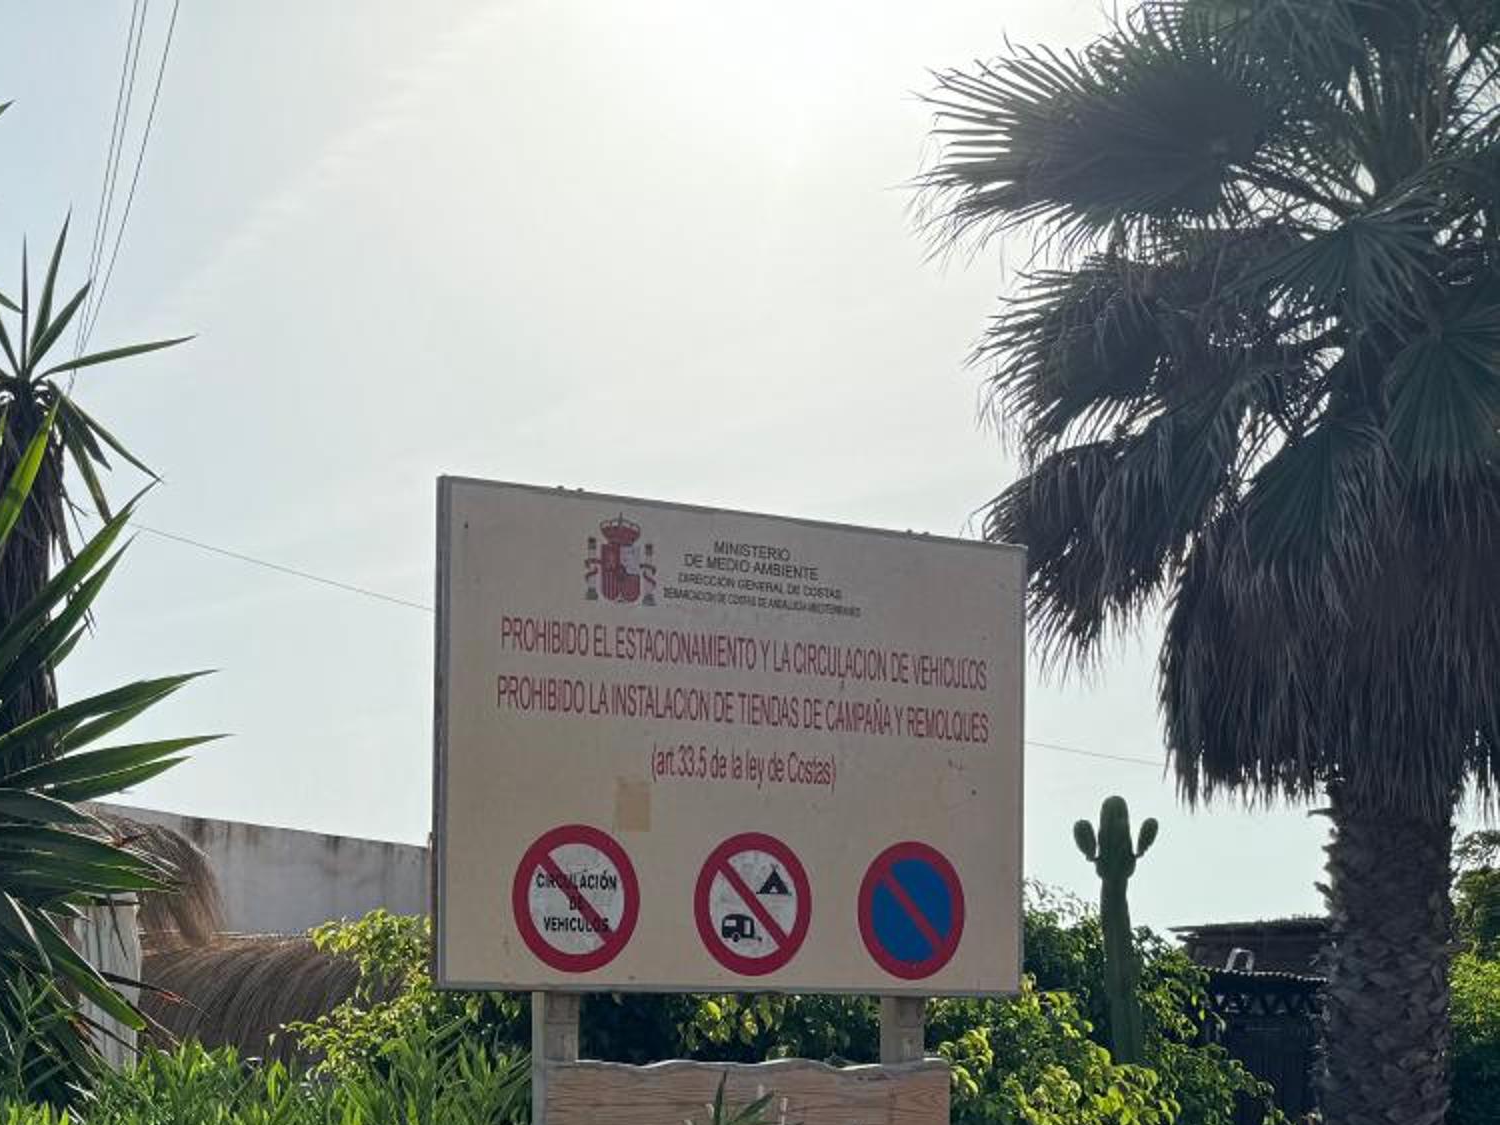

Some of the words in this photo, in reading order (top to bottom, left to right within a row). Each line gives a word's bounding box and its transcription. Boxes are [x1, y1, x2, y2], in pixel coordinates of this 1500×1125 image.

[684, 553, 704, 568] DE
[706, 555, 749, 573] MEDIO
[753, 562, 819, 582] AMBIENTE
[713, 541, 791, 562] MINISTERIO
[737, 579, 785, 596] GENERAL
[787, 583, 800, 596] DE
[803, 586, 843, 600] COSTAS
[500, 616, 589, 657] PROHIBIDO
[593, 624, 612, 658] EL
[616, 626, 757, 670] ESTACIONAMIENTO
[760, 639, 770, 672] Y
[773, 640, 790, 672] LA
[793, 642, 887, 682] CIRCULACION
[891, 652, 909, 683] DE
[912, 655, 988, 690] VEHICULOS
[496, 675, 585, 713] PROHIBIDO
[589, 680, 609, 715] LA
[612, 683, 709, 721] INSTALACION
[714, 692, 734, 723] DE
[738, 692, 799, 728] TIENDAS
[803, 698, 823, 730] DE
[826, 698, 891, 735] CAMPAÑA
[893, 703, 903, 735] Y
[907, 706, 989, 743] REMOLQUES
[710, 746, 727, 779] de
[731, 745, 742, 780] la
[745, 747, 764, 790] ley
[768, 751, 785, 782] de
[787, 751, 837, 792] Costas)
